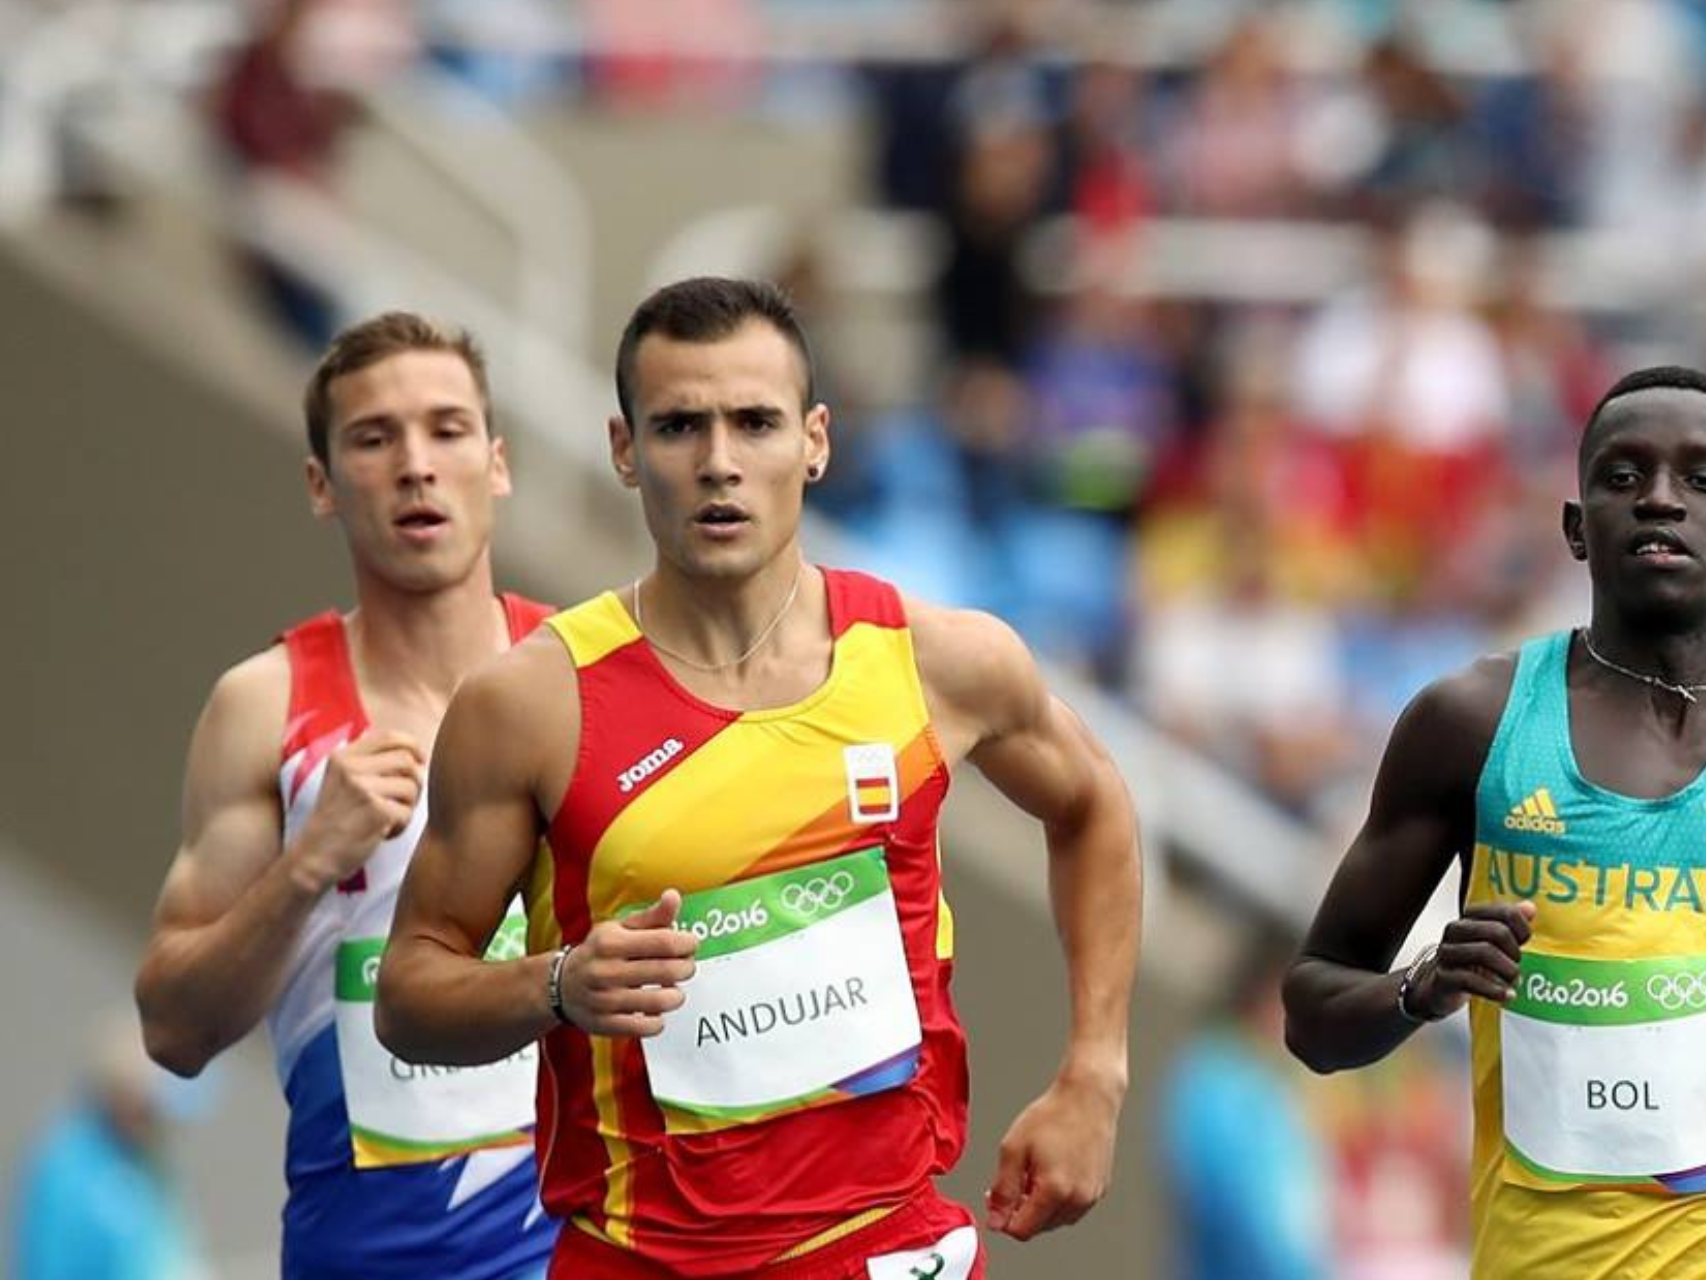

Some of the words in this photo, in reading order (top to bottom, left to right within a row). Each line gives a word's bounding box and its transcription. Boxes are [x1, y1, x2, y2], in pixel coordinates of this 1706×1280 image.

[1504, 815, 1566, 835] adidas
[1487, 848, 1703, 913] AUSTRA
[1527, 973, 1629, 1007] Rio2016
[696, 976, 868, 1048] ANDUJAR
[1586, 1079, 1660, 1110] BOL
